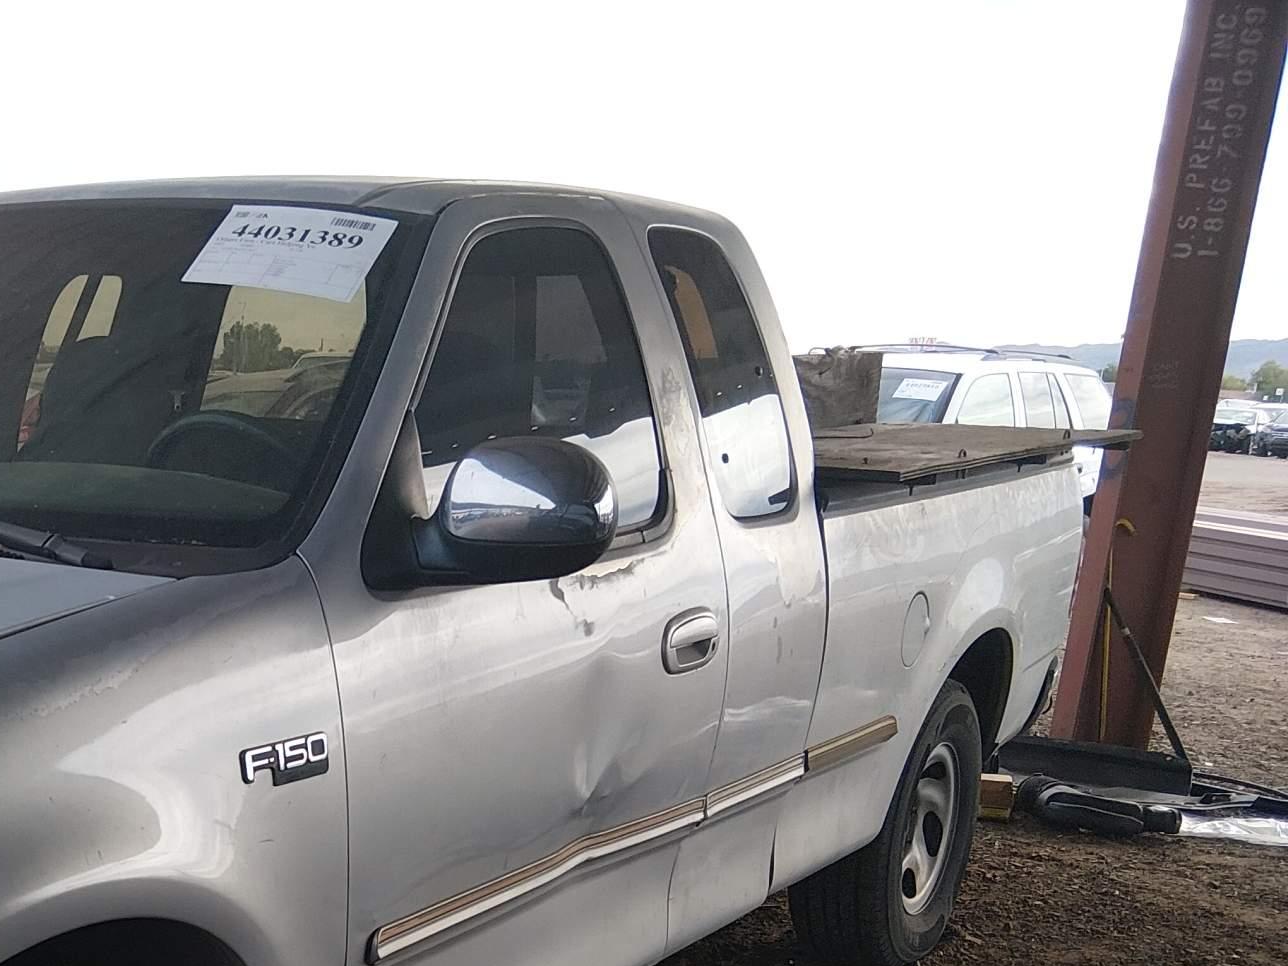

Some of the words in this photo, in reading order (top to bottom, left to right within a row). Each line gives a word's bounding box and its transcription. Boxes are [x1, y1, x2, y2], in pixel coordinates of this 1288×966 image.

[1210, 3, 1242, 60] INC.
[1185, 77, 1225, 189] PREFAB
[231, 223, 364, 250] 44031389
[1172, 207, 1201, 259] U.S.
